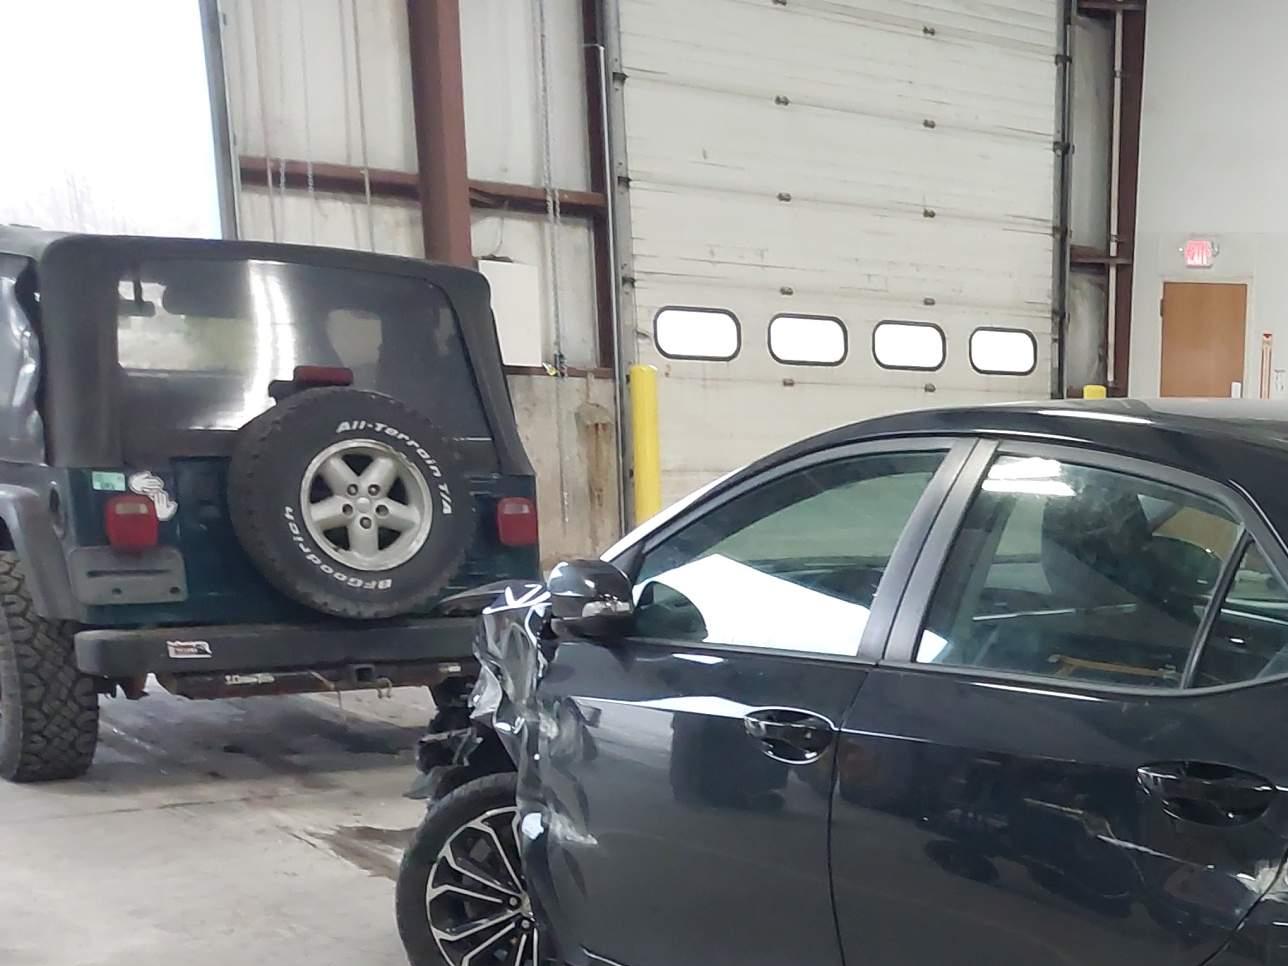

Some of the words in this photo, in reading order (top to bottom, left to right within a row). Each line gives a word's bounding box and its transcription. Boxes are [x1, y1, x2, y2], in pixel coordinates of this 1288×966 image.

[336, 420, 442, 478] All-Terrain
[438, 482, 453, 515] T/A
[284, 506, 393, 590] BFGoodrich
